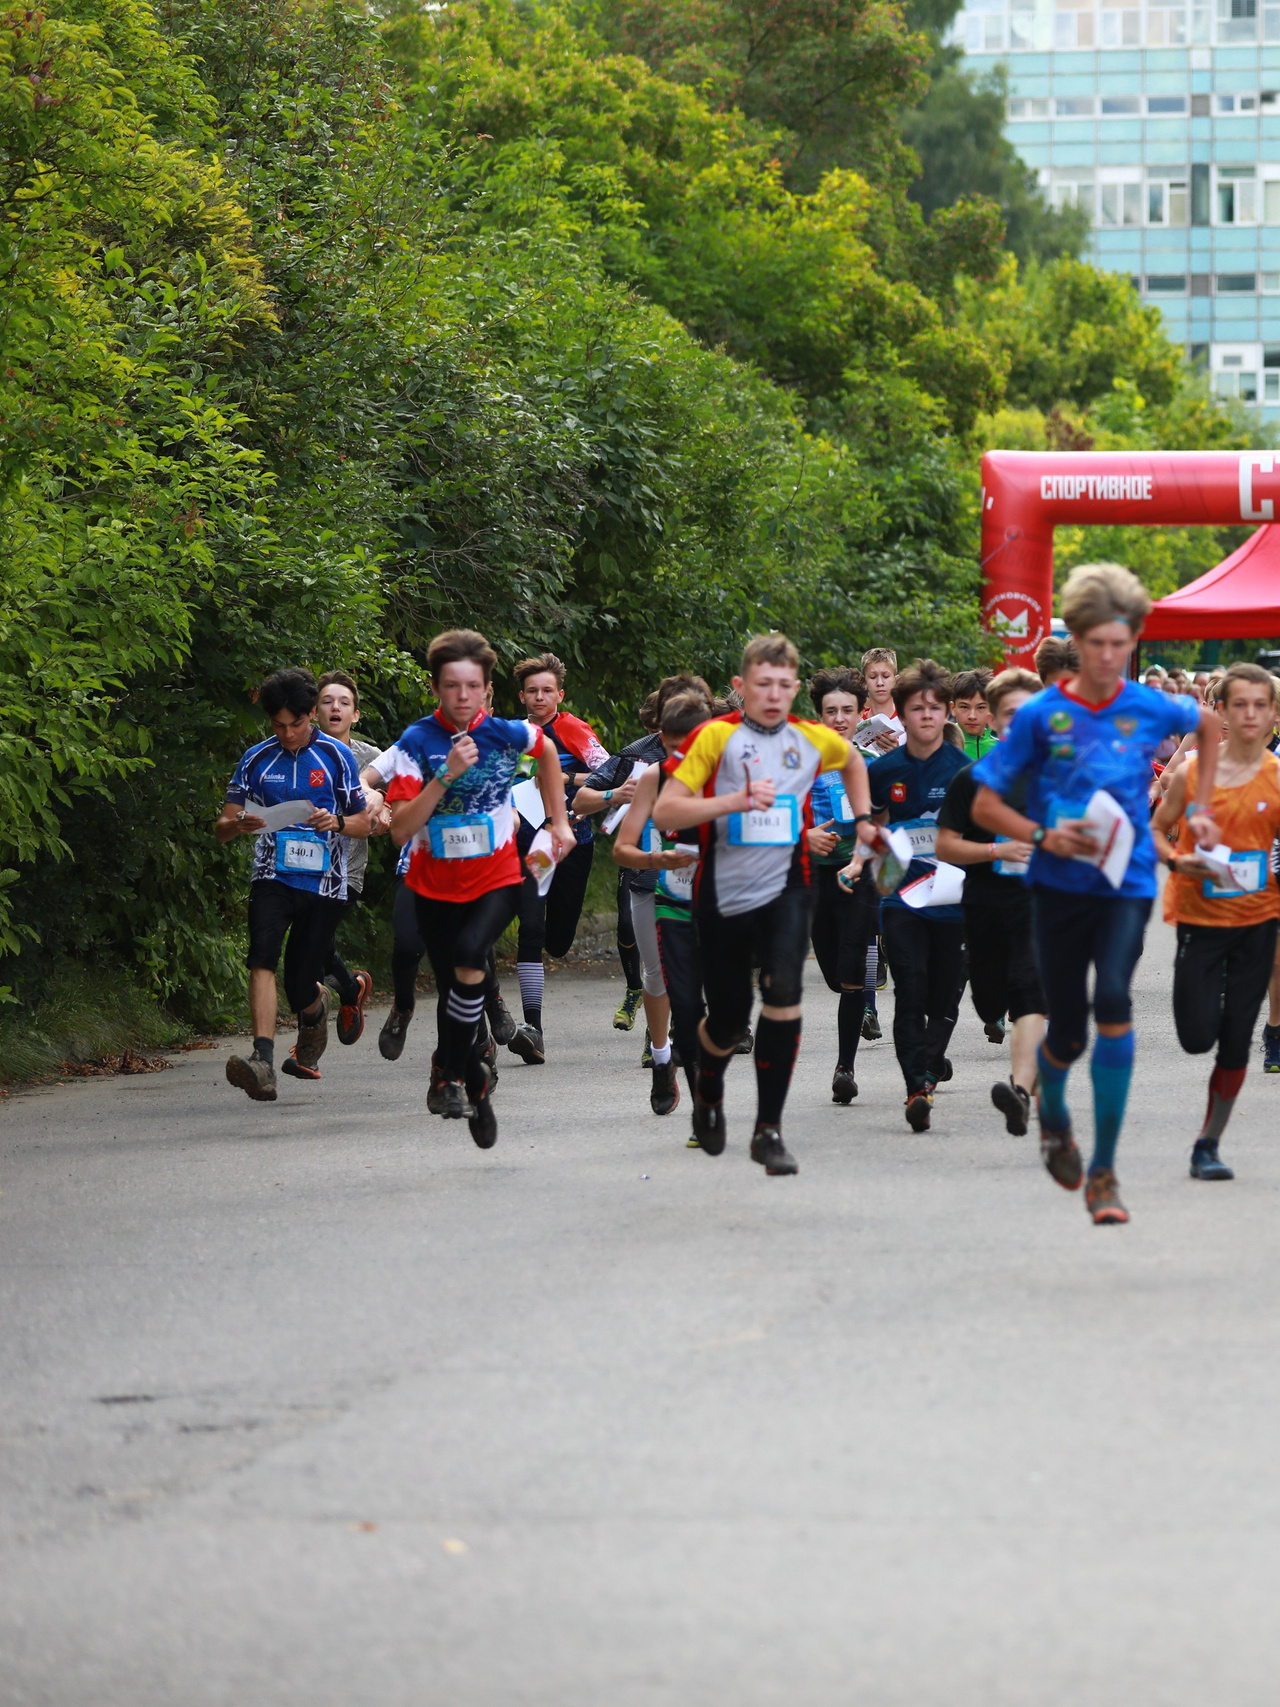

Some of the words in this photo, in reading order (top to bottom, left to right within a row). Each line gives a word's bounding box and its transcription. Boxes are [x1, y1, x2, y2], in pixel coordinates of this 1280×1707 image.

[1041, 475, 1152, 500] СПОРТИВНОЕ
[448, 833, 477, 845] 330.1
[910, 834, 934, 845] 319.1
[289, 847, 314, 858] 340.1
